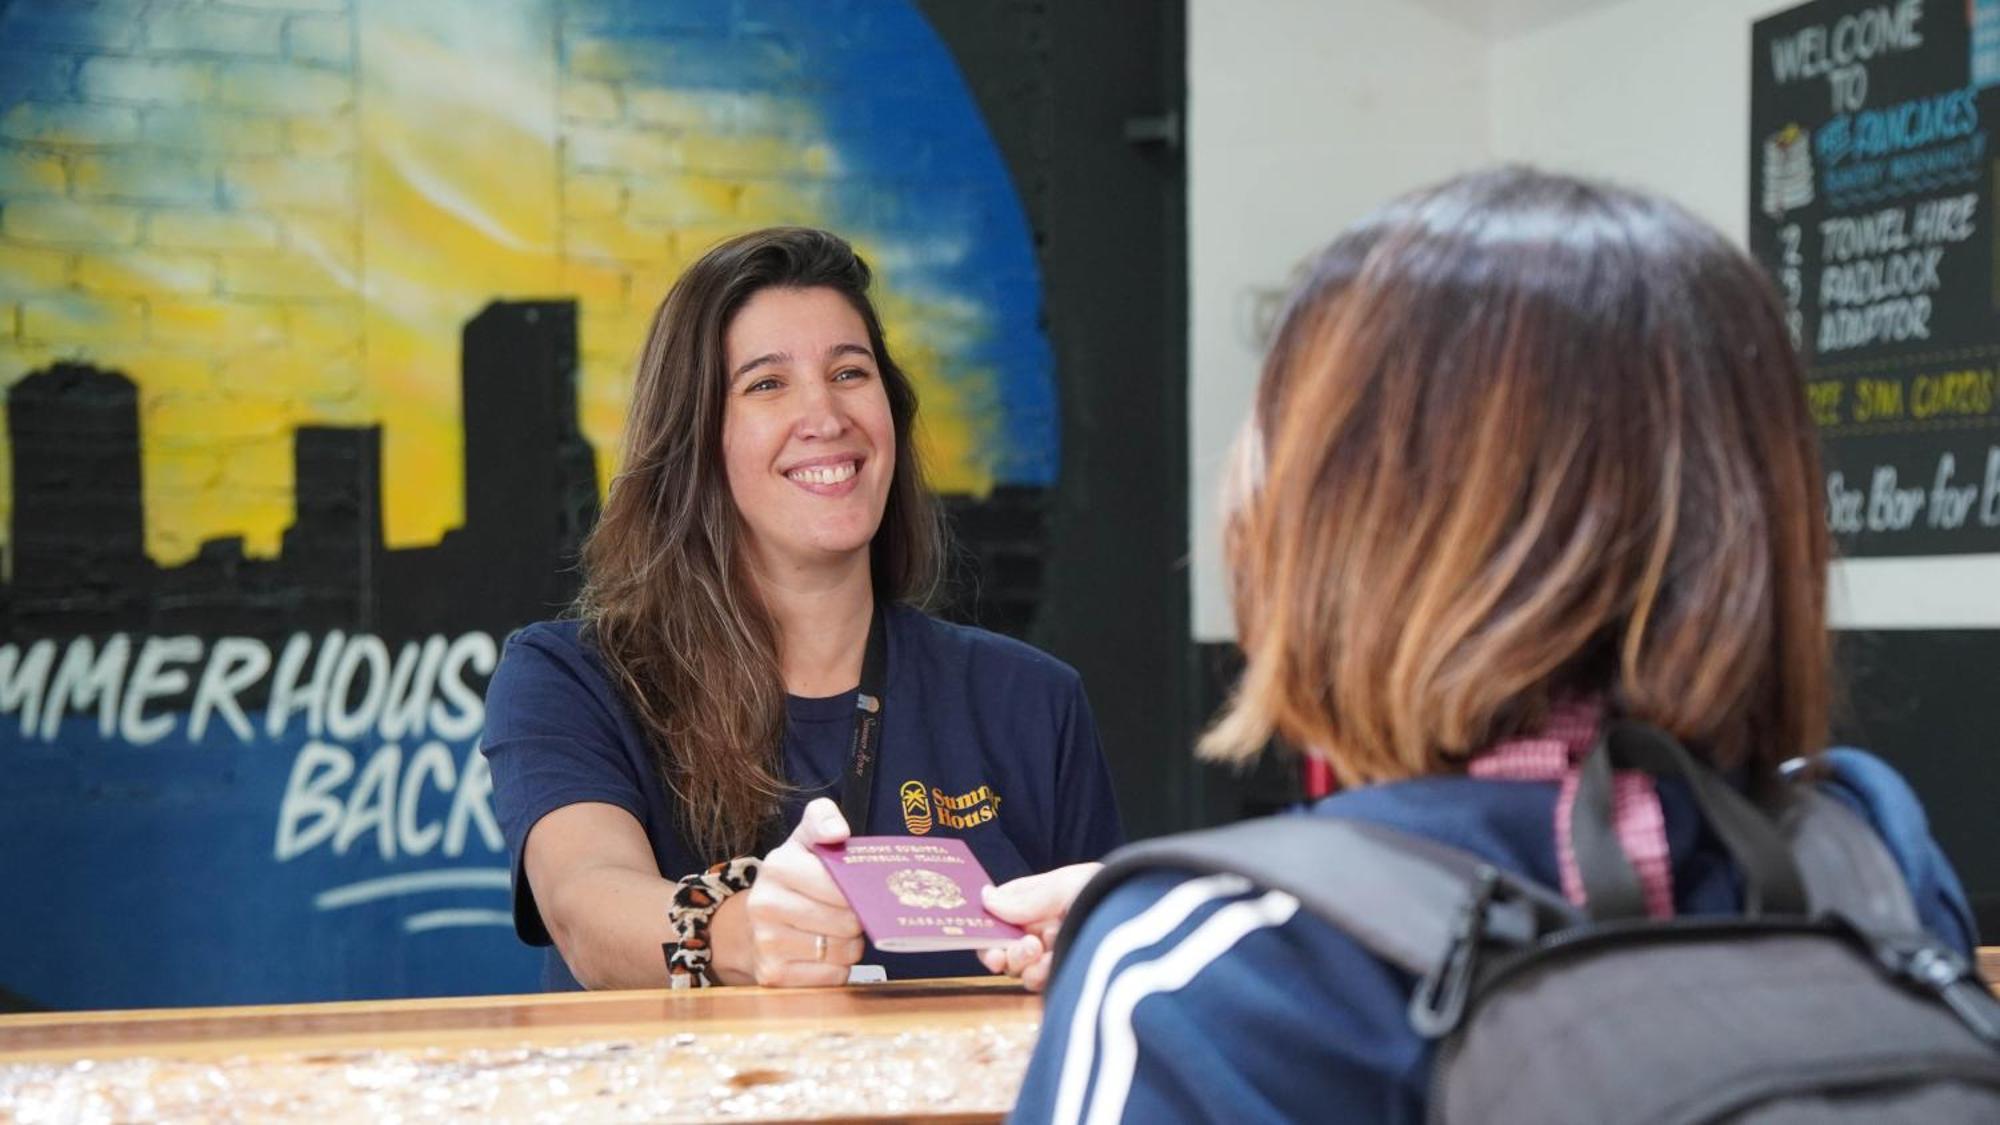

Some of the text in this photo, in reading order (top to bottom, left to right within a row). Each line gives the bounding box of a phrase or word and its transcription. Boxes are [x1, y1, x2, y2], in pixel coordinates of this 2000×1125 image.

[1770, 0, 1924, 82] WELCOME
[1828, 63, 1868, 112] TO
[1851, 88, 1978, 157] PANCAKES
[1819, 207, 1909, 261] TOWEL
[1911, 193, 1979, 245] HIRE
[1819, 248, 1944, 308] PADLOCK
[1817, 295, 1933, 353] ADAPTOR
[1854, 377, 1904, 423] SIM
[1911, 369, 1993, 420] CARDS
[1867, 465, 1926, 532] Bar
[1927, 452, 1978, 530] for
